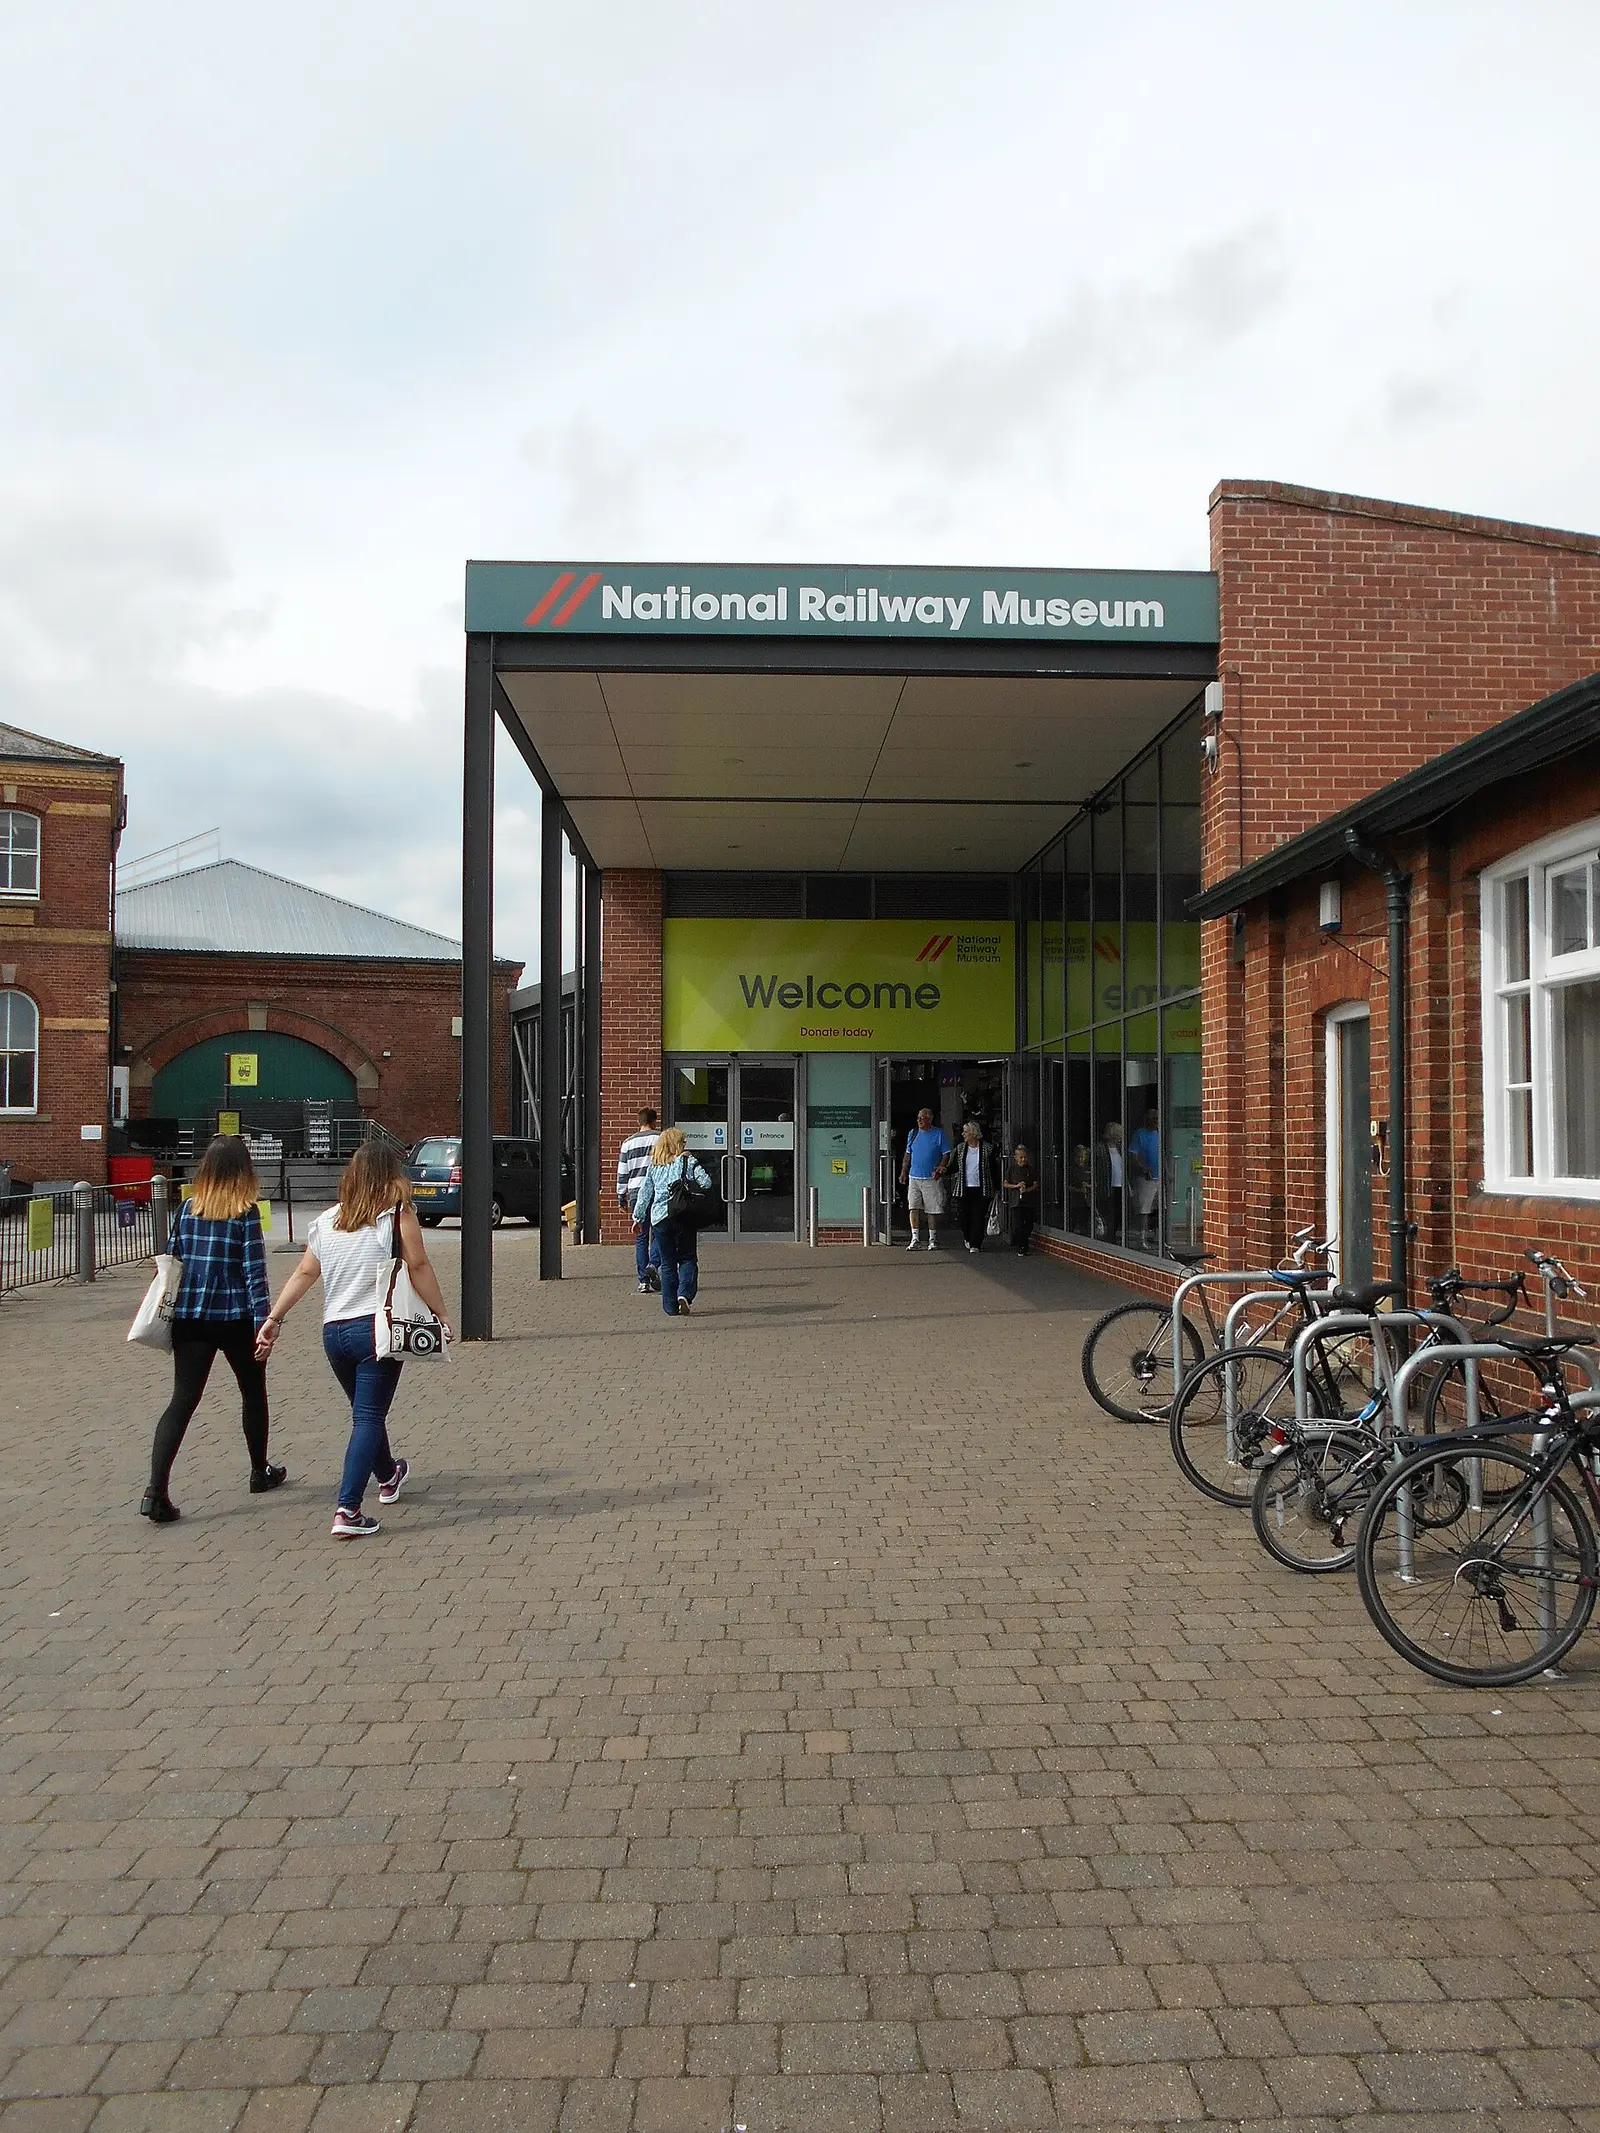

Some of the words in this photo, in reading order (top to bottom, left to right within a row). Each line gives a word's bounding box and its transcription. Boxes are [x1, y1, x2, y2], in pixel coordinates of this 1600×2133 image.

[602, 585, 788, 621] National
[799, 587, 971, 630] Railway
[983, 590, 1164, 628] Museum
[956, 935, 1001, 944] National
[956, 944, 998, 954] Railway
[956, 953, 1001, 963] Museum
[738, 974, 941, 1010] Welcome
[800, 1027, 840, 1037] Donate
[842, 1027, 874, 1038] today
